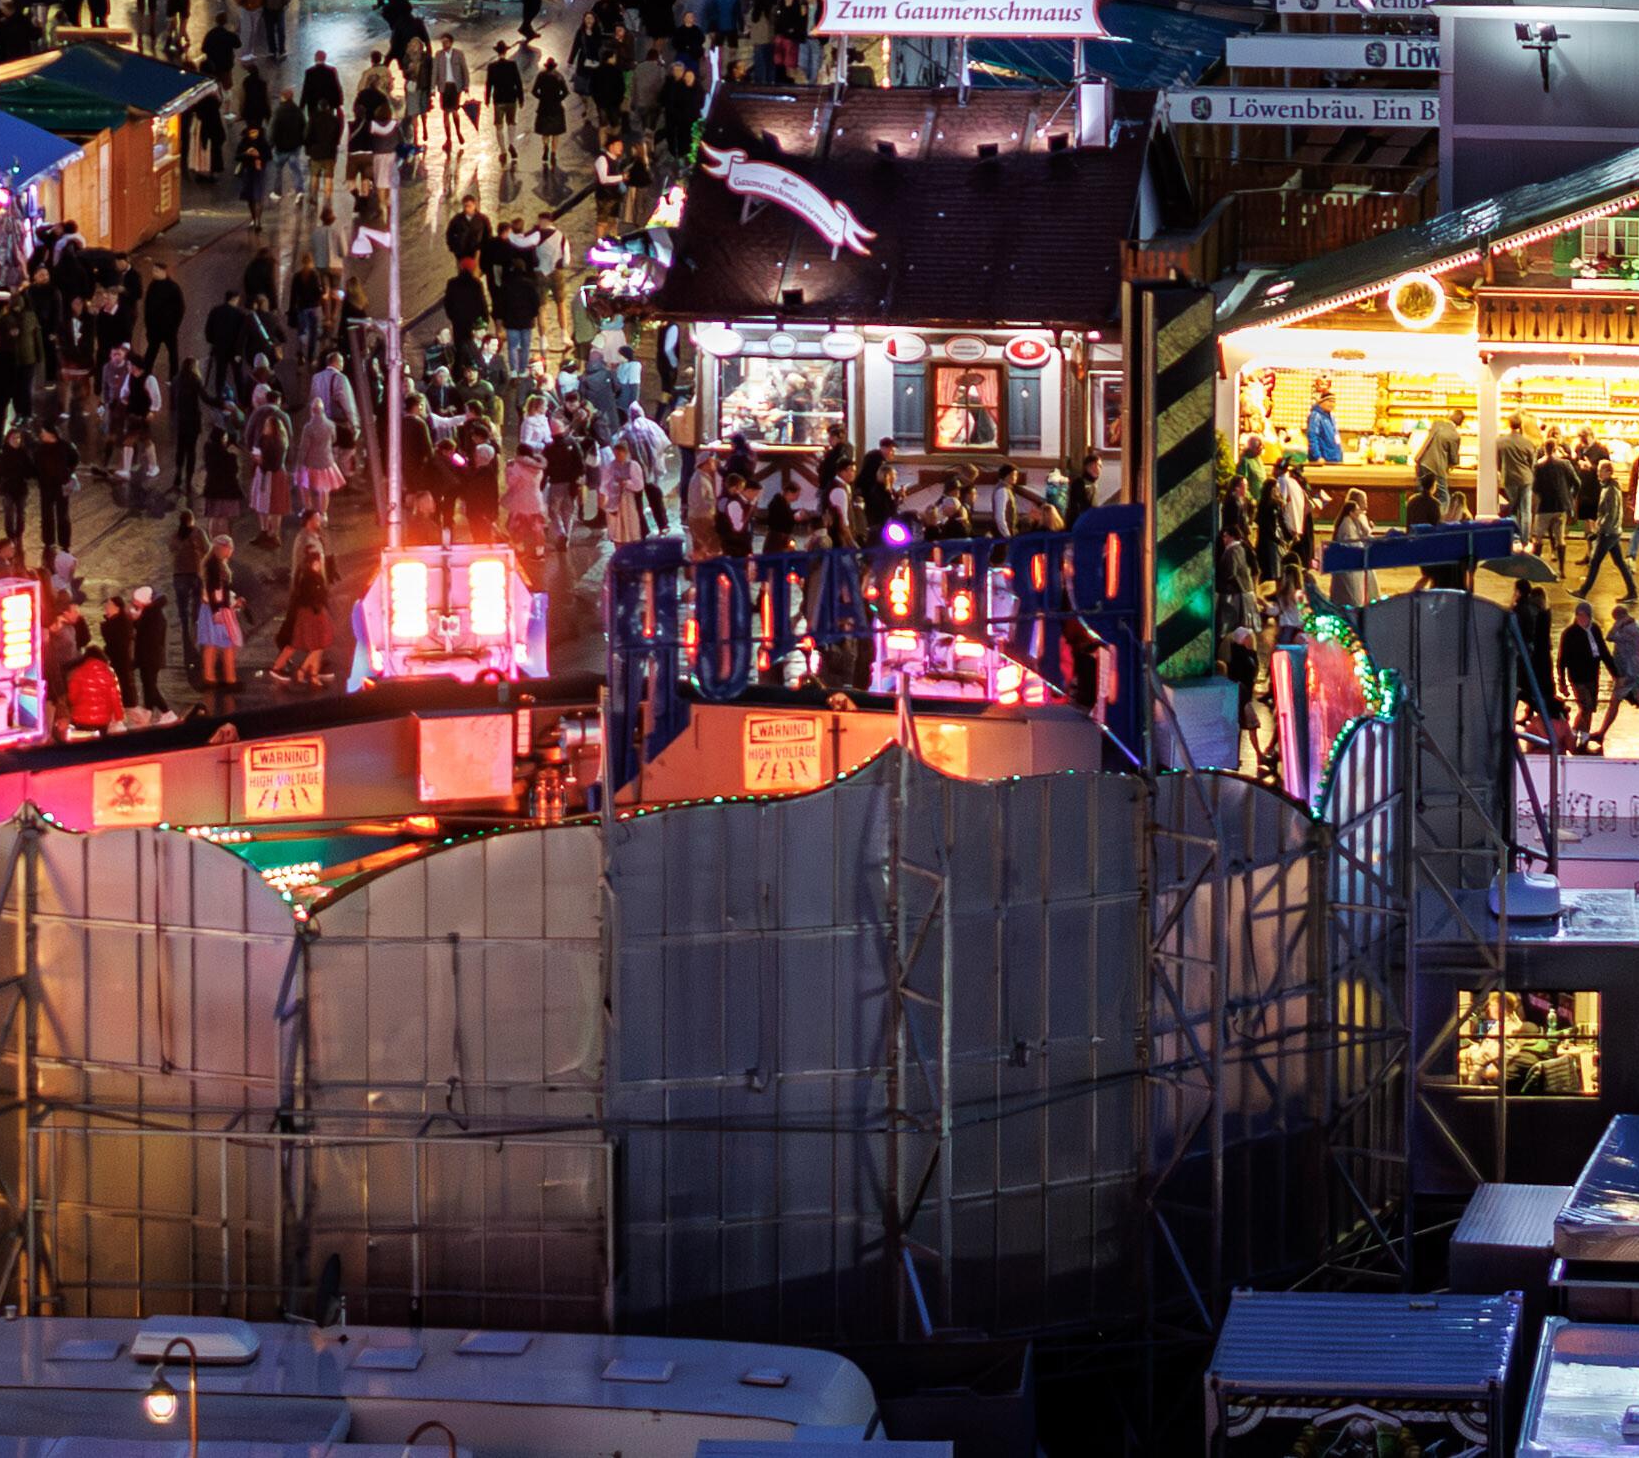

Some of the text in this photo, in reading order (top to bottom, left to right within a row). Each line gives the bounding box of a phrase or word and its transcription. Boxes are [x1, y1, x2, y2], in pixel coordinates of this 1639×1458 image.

[836, 1, 1084, 24] Zum Gaumenschmaus
[1229, 97, 1364, 121] Löwenbräu.
[1372, 98, 1413, 121] Ein
[760, 721, 809, 739] WARNING
[260, 748, 313, 768] WARNING
[748, 744, 817, 760] HIGH VOLTAGE
[250, 773, 319, 788] HIGH VOLTAGE
